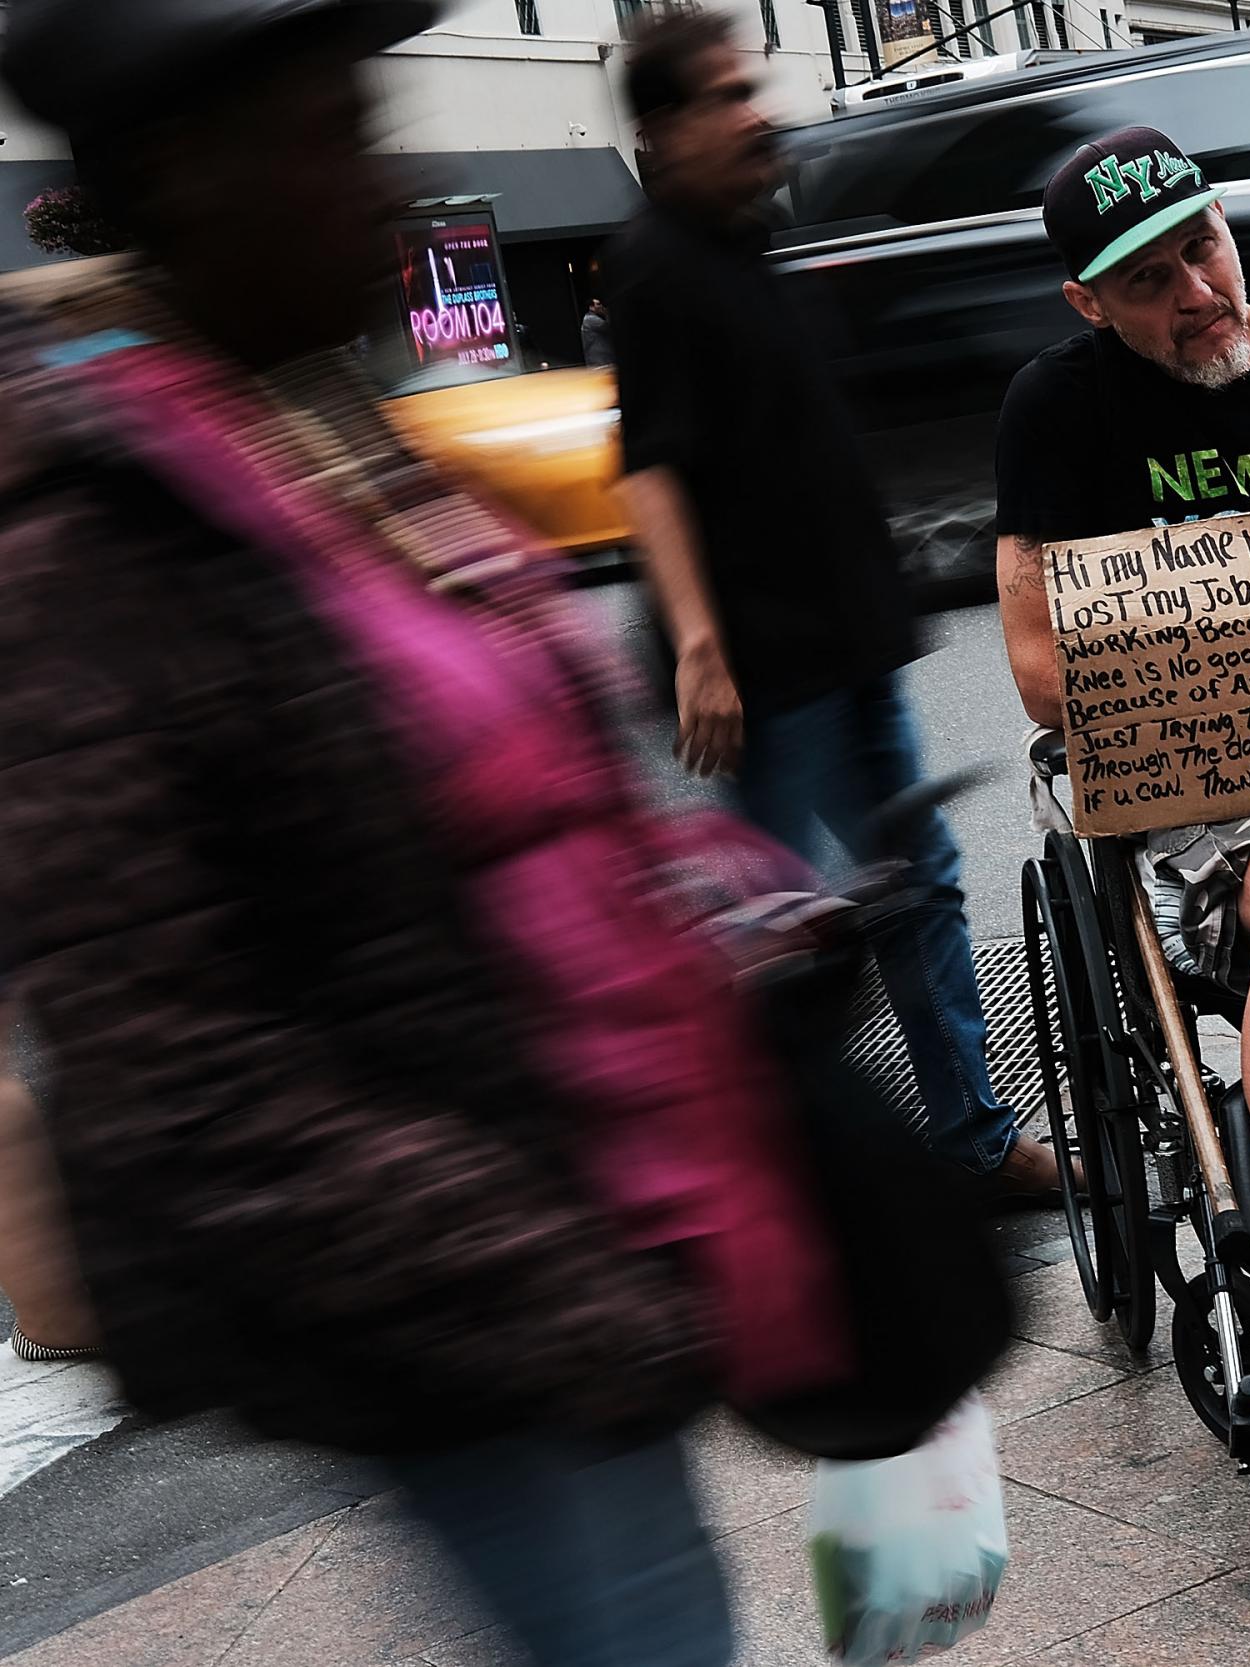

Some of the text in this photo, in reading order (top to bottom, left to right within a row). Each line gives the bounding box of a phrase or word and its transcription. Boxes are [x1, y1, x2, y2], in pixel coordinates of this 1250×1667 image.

[410, 301, 505, 344] ROOM 104
[1051, 549, 1091, 594] Hi
[1100, 550, 1148, 592] my
[1150, 529, 1237, 573] Name
[1141, 586, 1193, 624] my
[1168, 653, 1202, 682] No
[1066, 686, 1179, 730] Because
